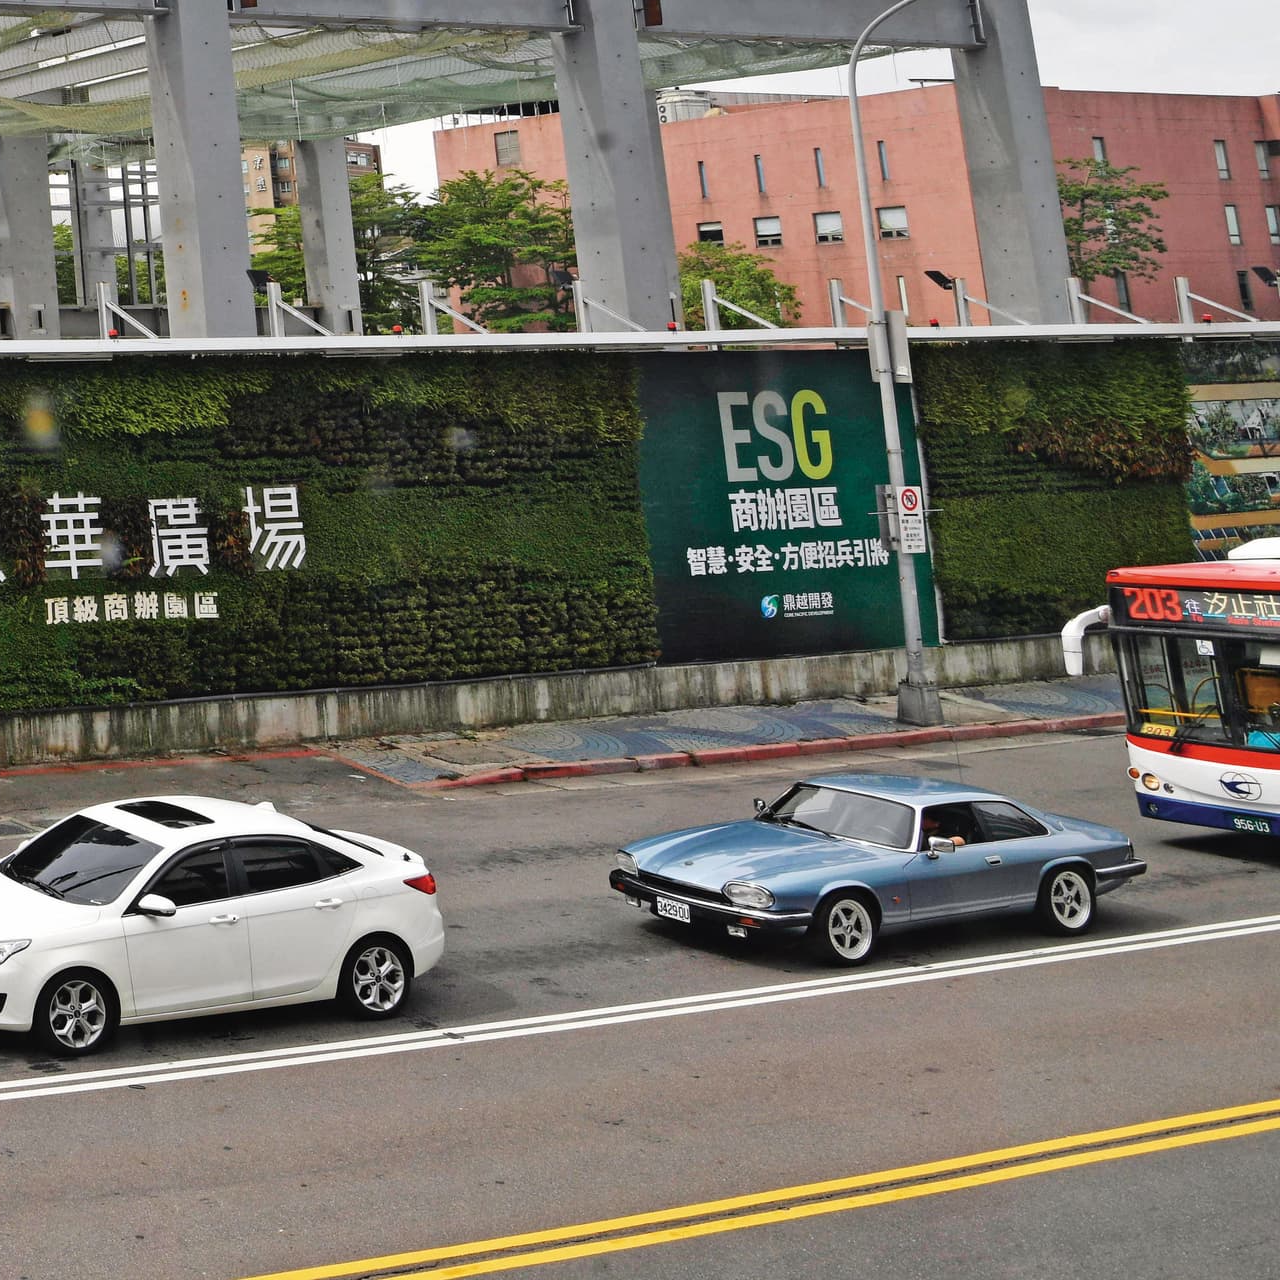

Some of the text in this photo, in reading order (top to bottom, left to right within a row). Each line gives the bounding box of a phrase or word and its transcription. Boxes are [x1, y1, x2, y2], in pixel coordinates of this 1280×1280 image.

[716, 389, 833, 483] ESG
[728, 486, 843, 532] 商辦園區
[44, 591, 220, 625] 頂級商辦園區
[783, 592, 834, 611] 鼎越開發
[1123, 587, 1184, 622] 203
[1184, 598, 1201, 614] 往
[1233, 817, 1270, 833] 956-U3
